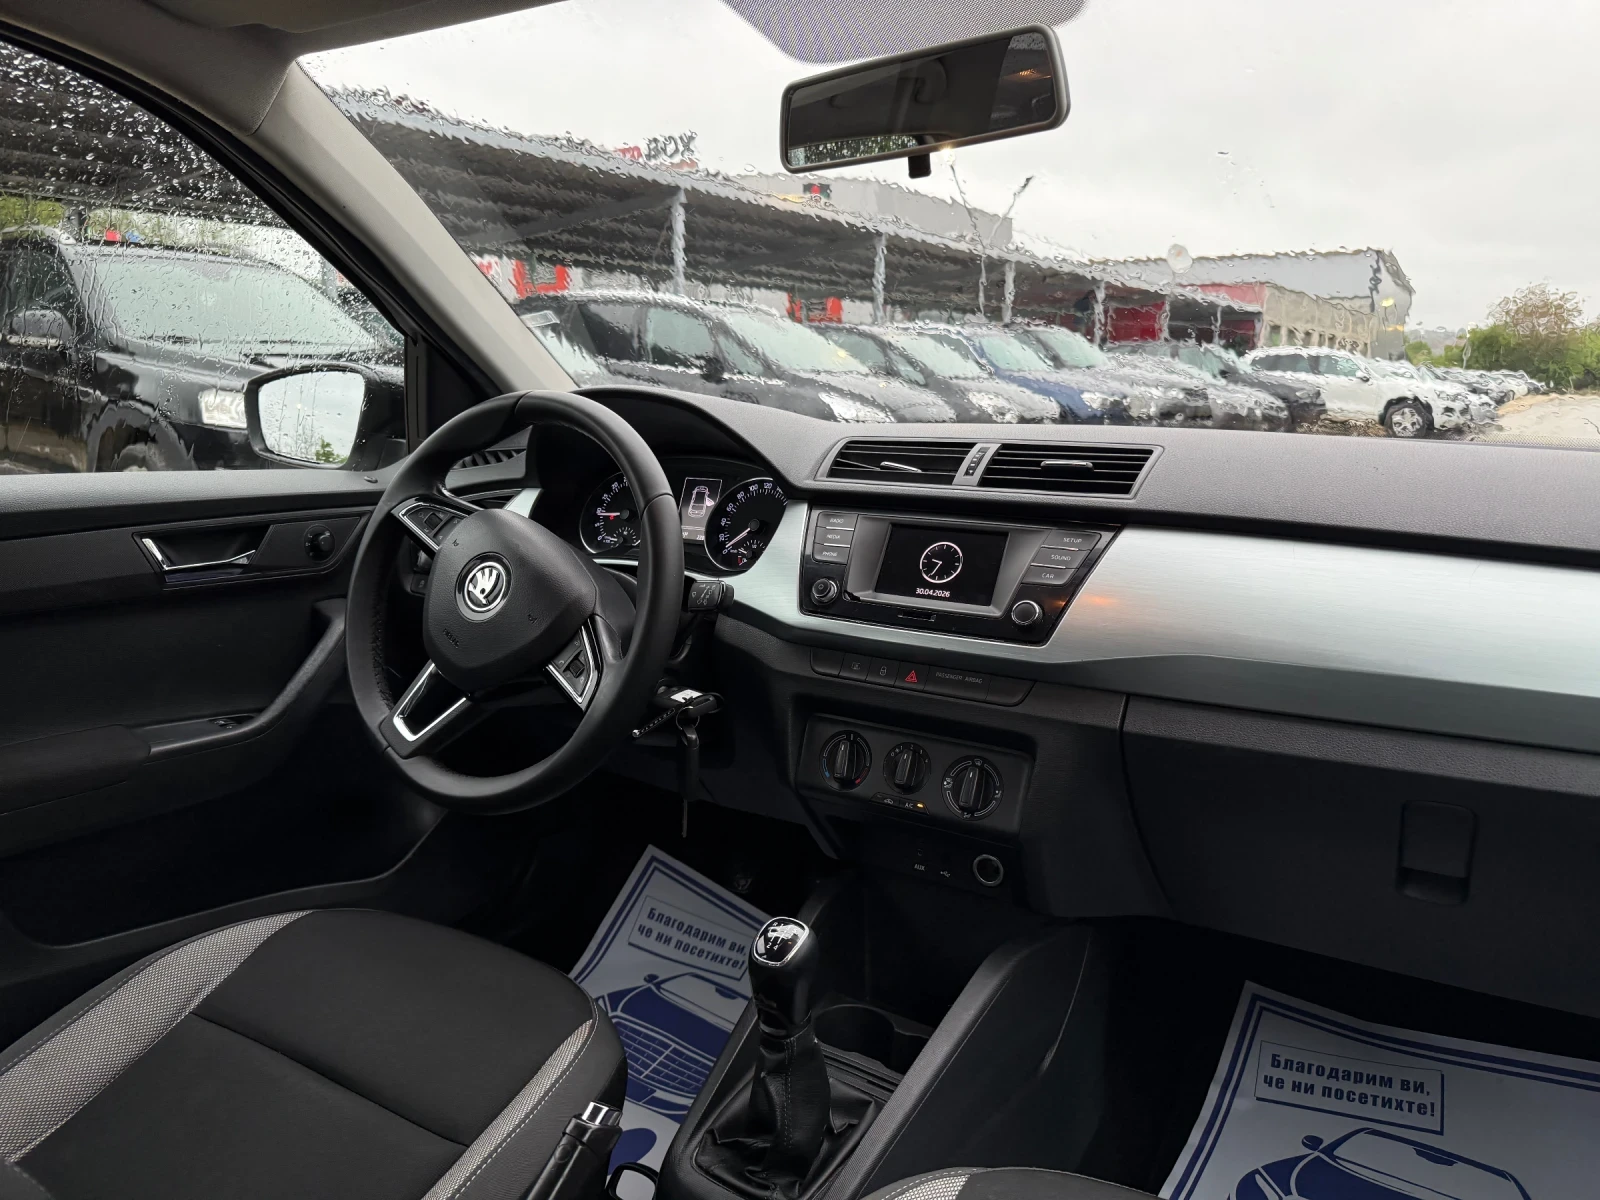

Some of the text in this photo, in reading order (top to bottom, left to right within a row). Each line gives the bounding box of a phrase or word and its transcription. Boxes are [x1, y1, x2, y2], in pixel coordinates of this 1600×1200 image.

[749, 483, 759, 492] 100
[736, 491, 745, 500] 80
[726, 502, 734, 512] 60
[720, 517, 727, 527] 40
[718, 533, 725, 542] 20
[915, 587, 950, 598] 30.04.2026
[935, 671, 983, 684] PASSENGER AIRBAG
[914, 863, 925, 872] AUX
[646, 907, 747, 956] Благодарим ви,
[637, 923, 745, 970] че ни посетихте!
[1270, 1053, 1430, 1096] Благодарим ви,
[1263, 1074, 1435, 1117] че ни посетихте!
